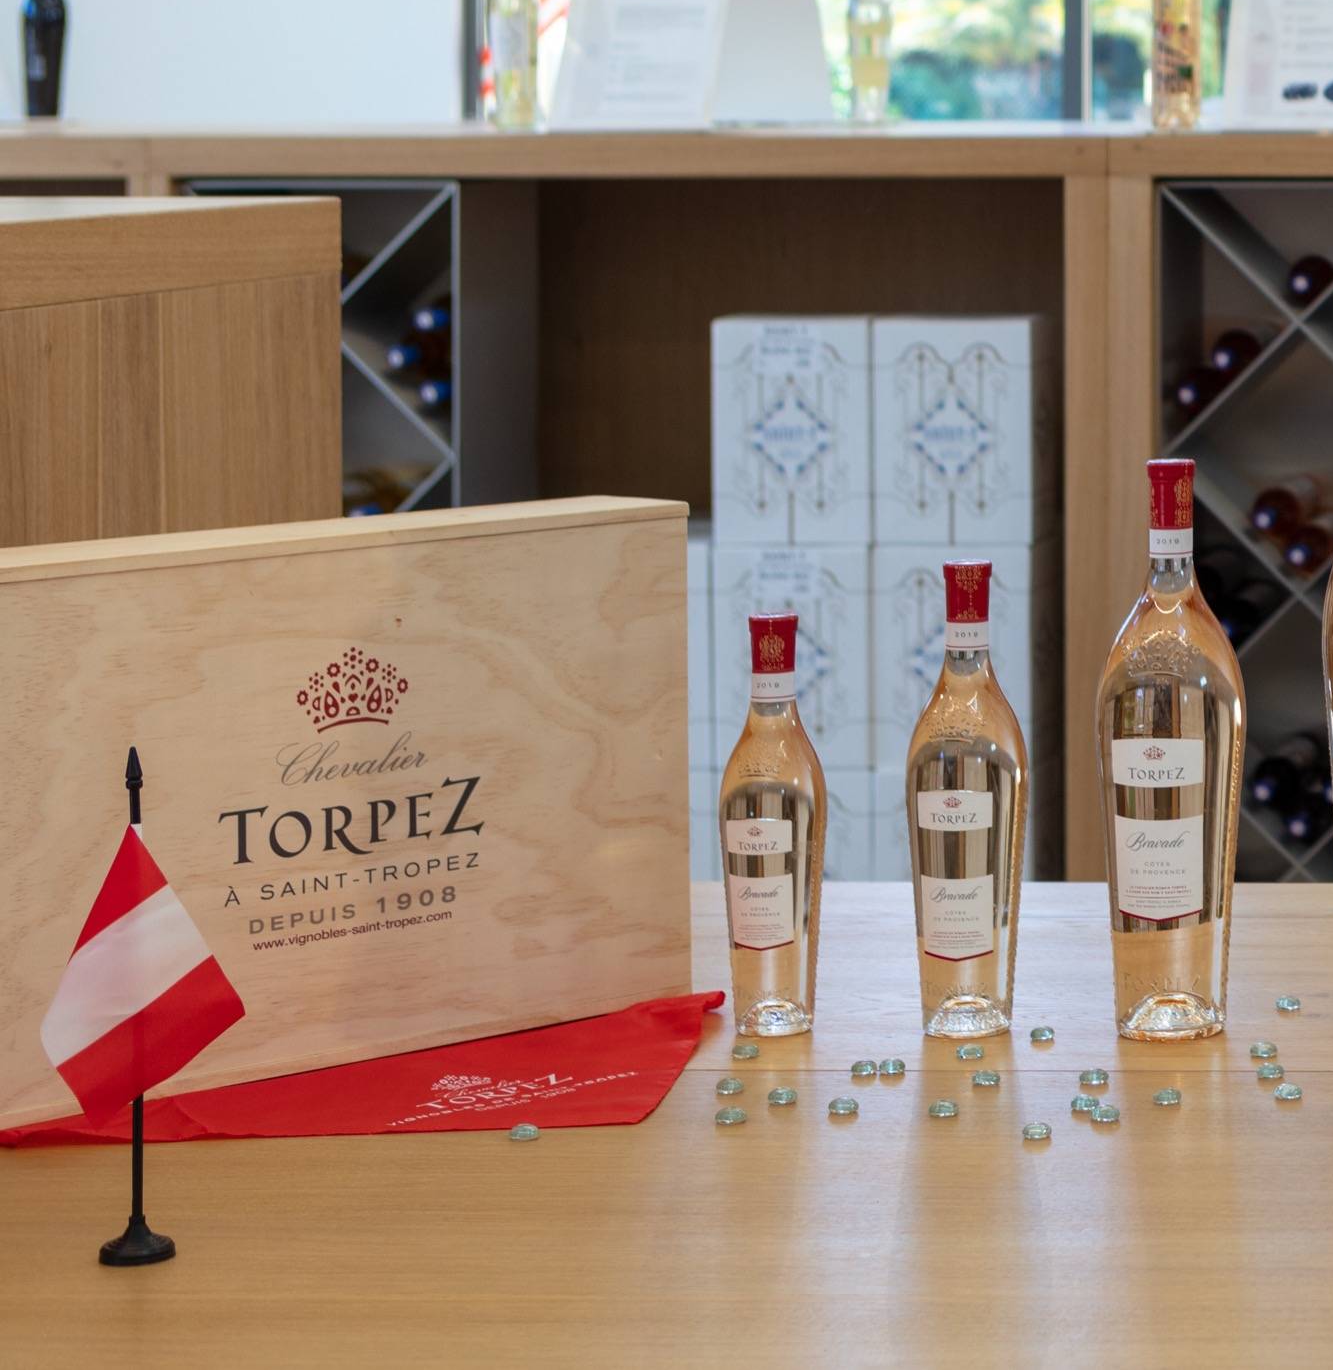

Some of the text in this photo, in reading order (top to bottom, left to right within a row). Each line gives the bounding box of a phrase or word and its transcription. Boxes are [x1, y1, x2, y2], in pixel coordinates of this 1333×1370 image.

[276, 731, 428, 786] Chevalier
[1128, 767, 1185, 782] TORPEZ
[218, 776, 485, 865] TORPEZ
[930, 813, 977, 825] TORPEZ
[738, 840, 778, 851] TORPEZ
[1126, 830, 1190, 852] Bravade
[224, 852, 479, 908] À SAINT-TROPEZ
[249, 886, 456, 934] DEPUIS 1908
[252, 910, 453, 951] www.vignobles-saint-tropez.com
[416, 1073, 573, 1109] TORPEZ
